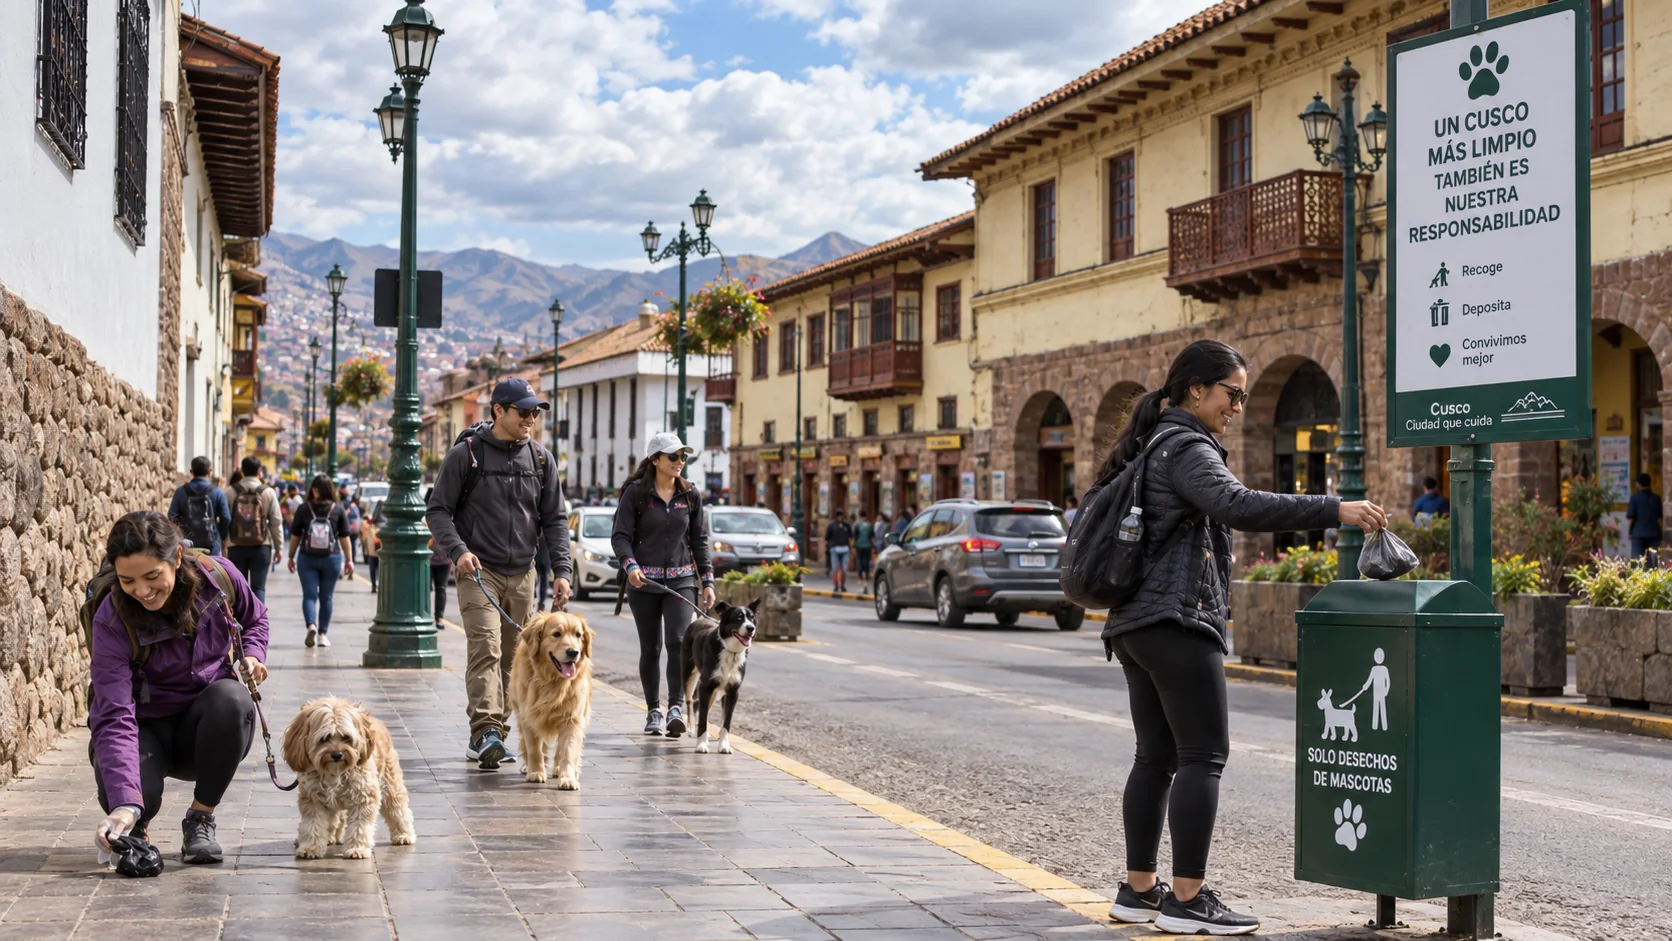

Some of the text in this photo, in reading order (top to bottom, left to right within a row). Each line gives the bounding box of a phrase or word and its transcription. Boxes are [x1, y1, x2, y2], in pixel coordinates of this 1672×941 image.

[1435, 102, 1528, 137] UN CUSCO
[1429, 129, 1536, 166] MÁS LIMPIO
[1434, 158, 1529, 190] TAMBIÉN ES
[1446, 185, 1518, 213] NUESTRA
[1410, 205, 1560, 243] RESPONSABILIDAD
[1463, 262, 1503, 276] Recoge
[1463, 300, 1511, 316] Deposita
[1463, 334, 1526, 349] Convivimos
[1463, 352, 1494, 367] mejor
[1431, 403, 1470, 415] Cusco
[1406, 415, 1492, 431] Ciudad que cuida
[1308, 747, 1397, 771] SOLO DESECHOS
[1314, 770, 1391, 793] DE MASCOTAS
